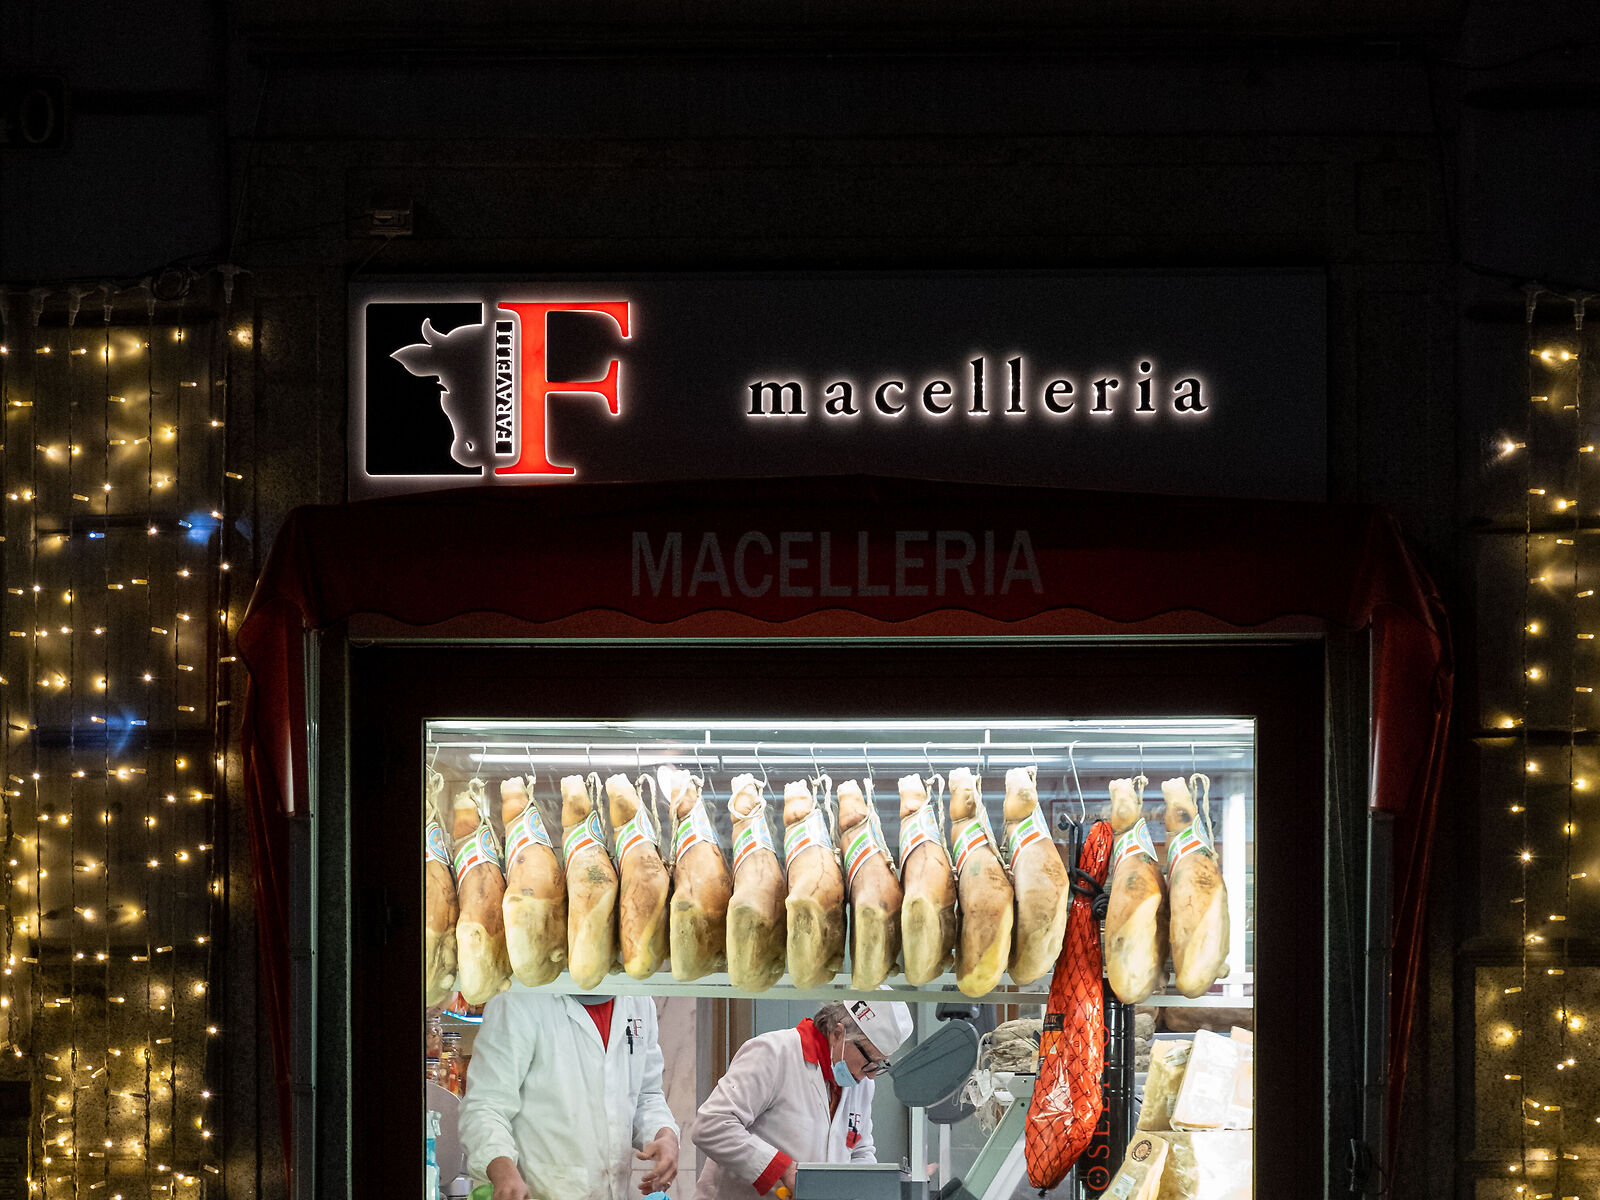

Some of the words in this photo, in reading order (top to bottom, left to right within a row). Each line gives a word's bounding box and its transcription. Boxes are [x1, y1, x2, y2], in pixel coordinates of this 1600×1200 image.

[494, 301, 632, 475] F
[495, 329, 513, 445] FARAVELLI
[745, 356, 1209, 417] macelleria
[630, 529, 1044, 598] MACELLERIA
